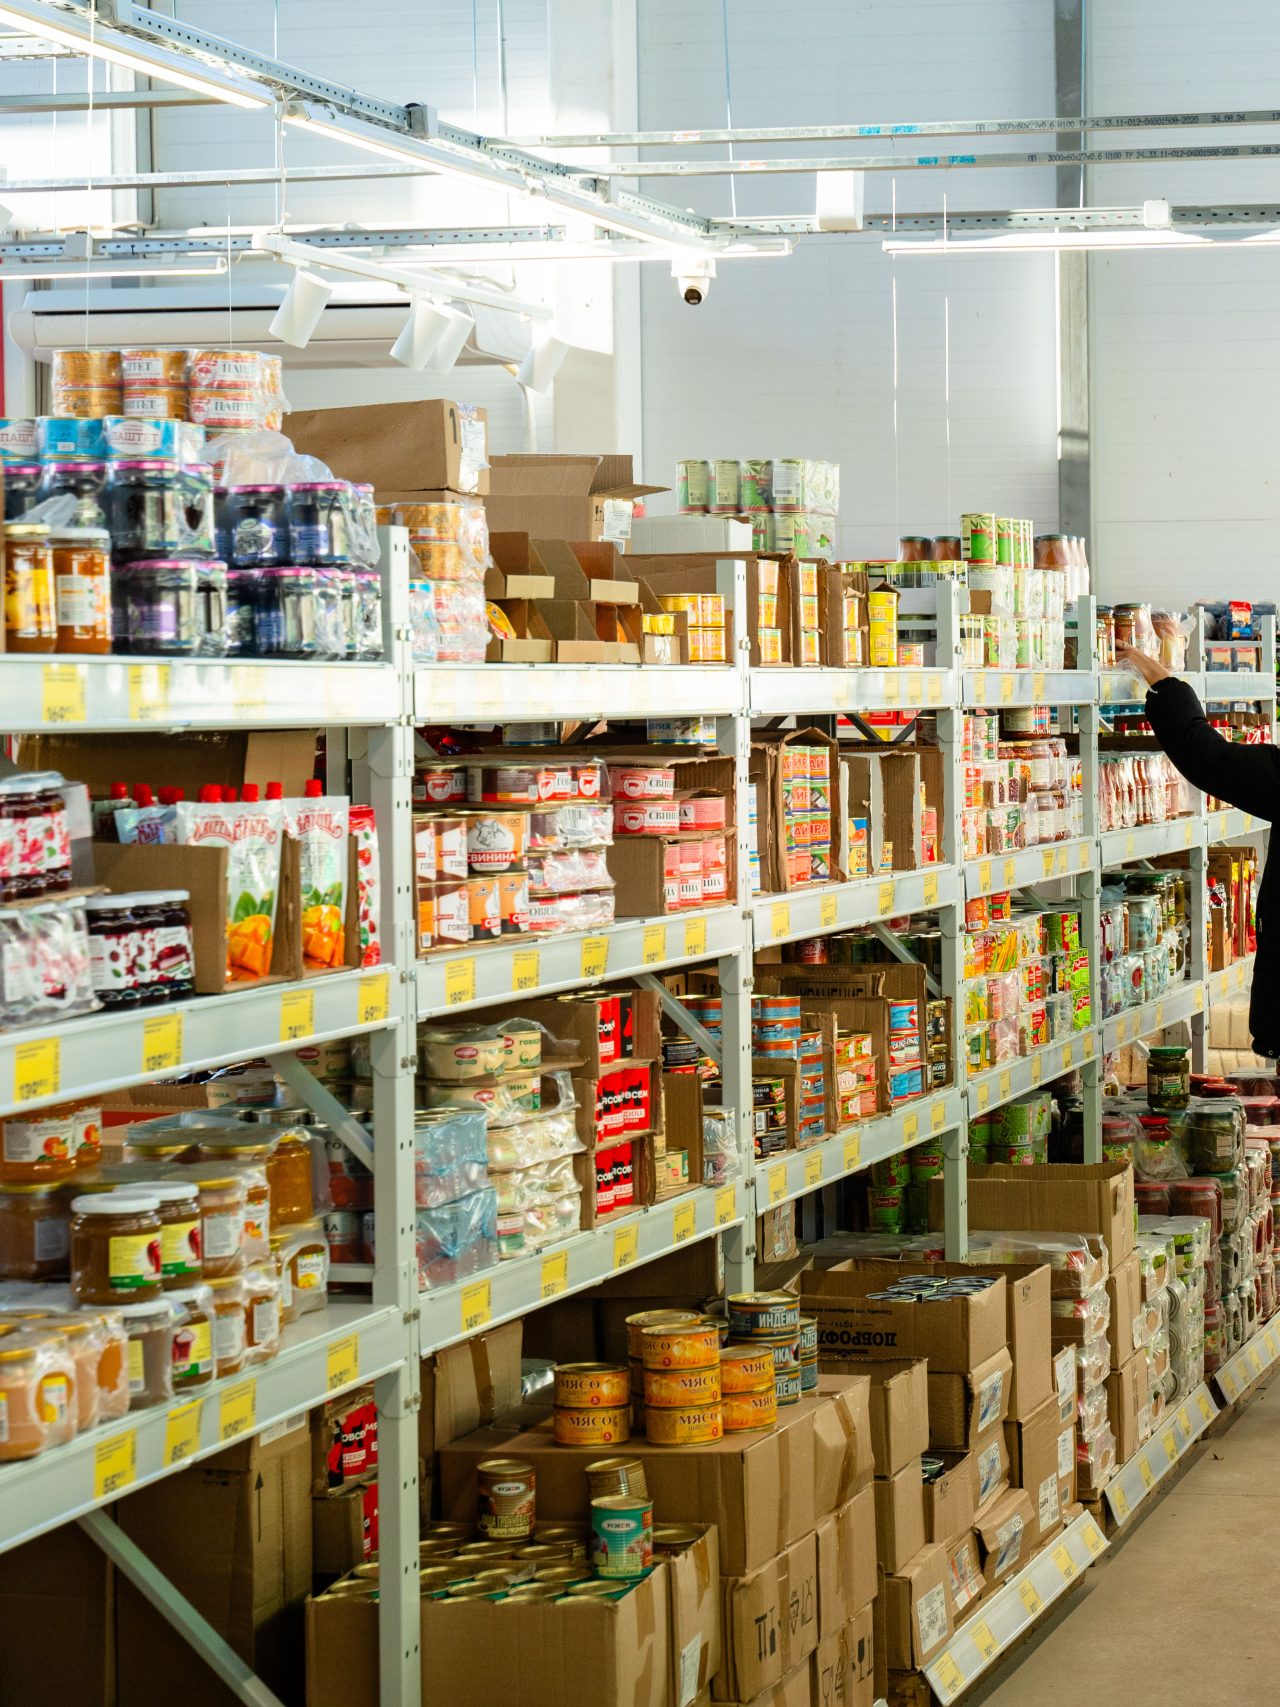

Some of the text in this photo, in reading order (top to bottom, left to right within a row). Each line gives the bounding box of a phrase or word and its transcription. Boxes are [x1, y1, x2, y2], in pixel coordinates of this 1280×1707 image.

[466, 851, 517, 863] СВИНИНА
[560, 1378, 600, 1390] МЯСО
[679, 1376, 717, 1389] МЯСО
[568, 1416, 612, 1428] МЯСО
[678, 1412, 717, 1426] МЯСО
